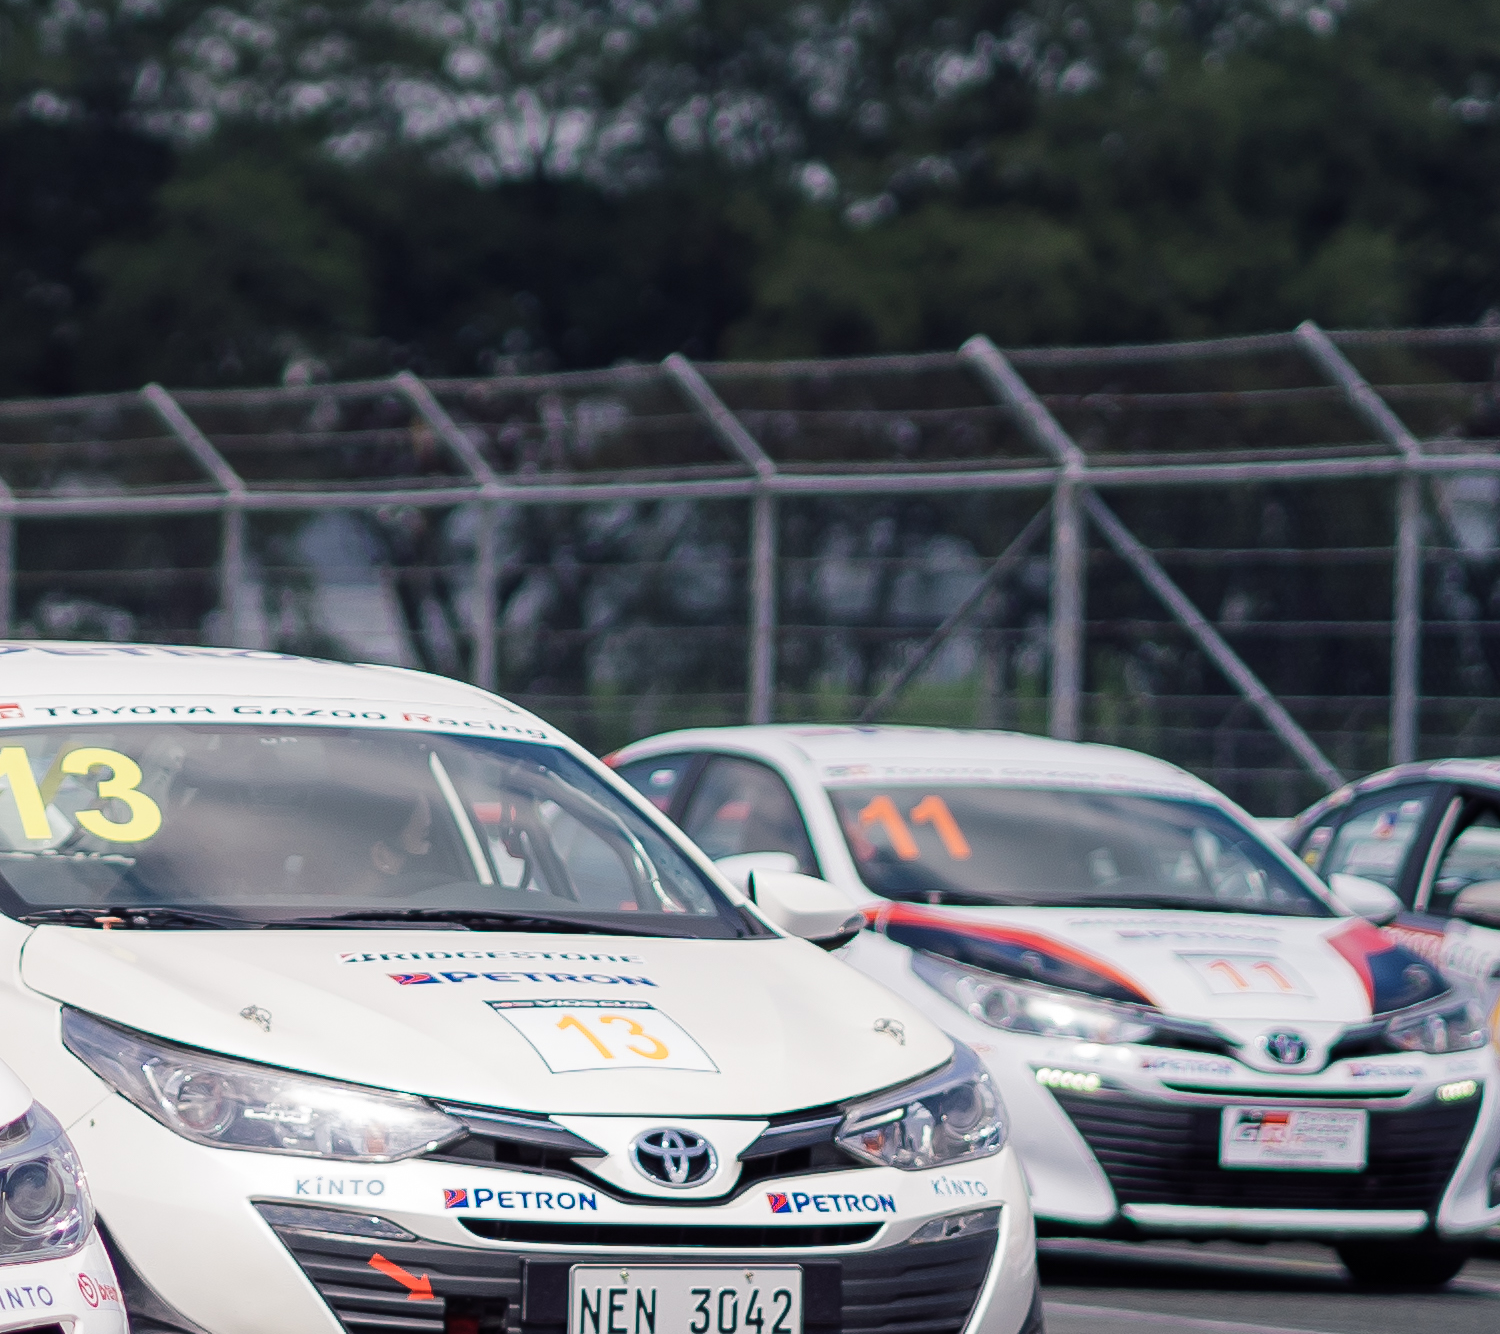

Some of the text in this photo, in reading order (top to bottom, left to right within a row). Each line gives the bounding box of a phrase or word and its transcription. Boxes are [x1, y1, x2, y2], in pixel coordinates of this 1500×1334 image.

[35, 705, 214, 717] TOYOTA
[232, 705, 387, 721] GAZOO
[401, 712, 547, 741] Racing
[858, 795, 971, 860] 11
[340, 950, 643, 964] BRIDGESTONE
[439, 971, 659, 988] PETRON
[1209, 960, 1294, 991] 11
[557, 1014, 669, 1061] 13
[475, 1188, 598, 1211] PETRON
[791, 1193, 896, 1214] PETRON
[579, 1289, 794, 1334] NEN 3042
